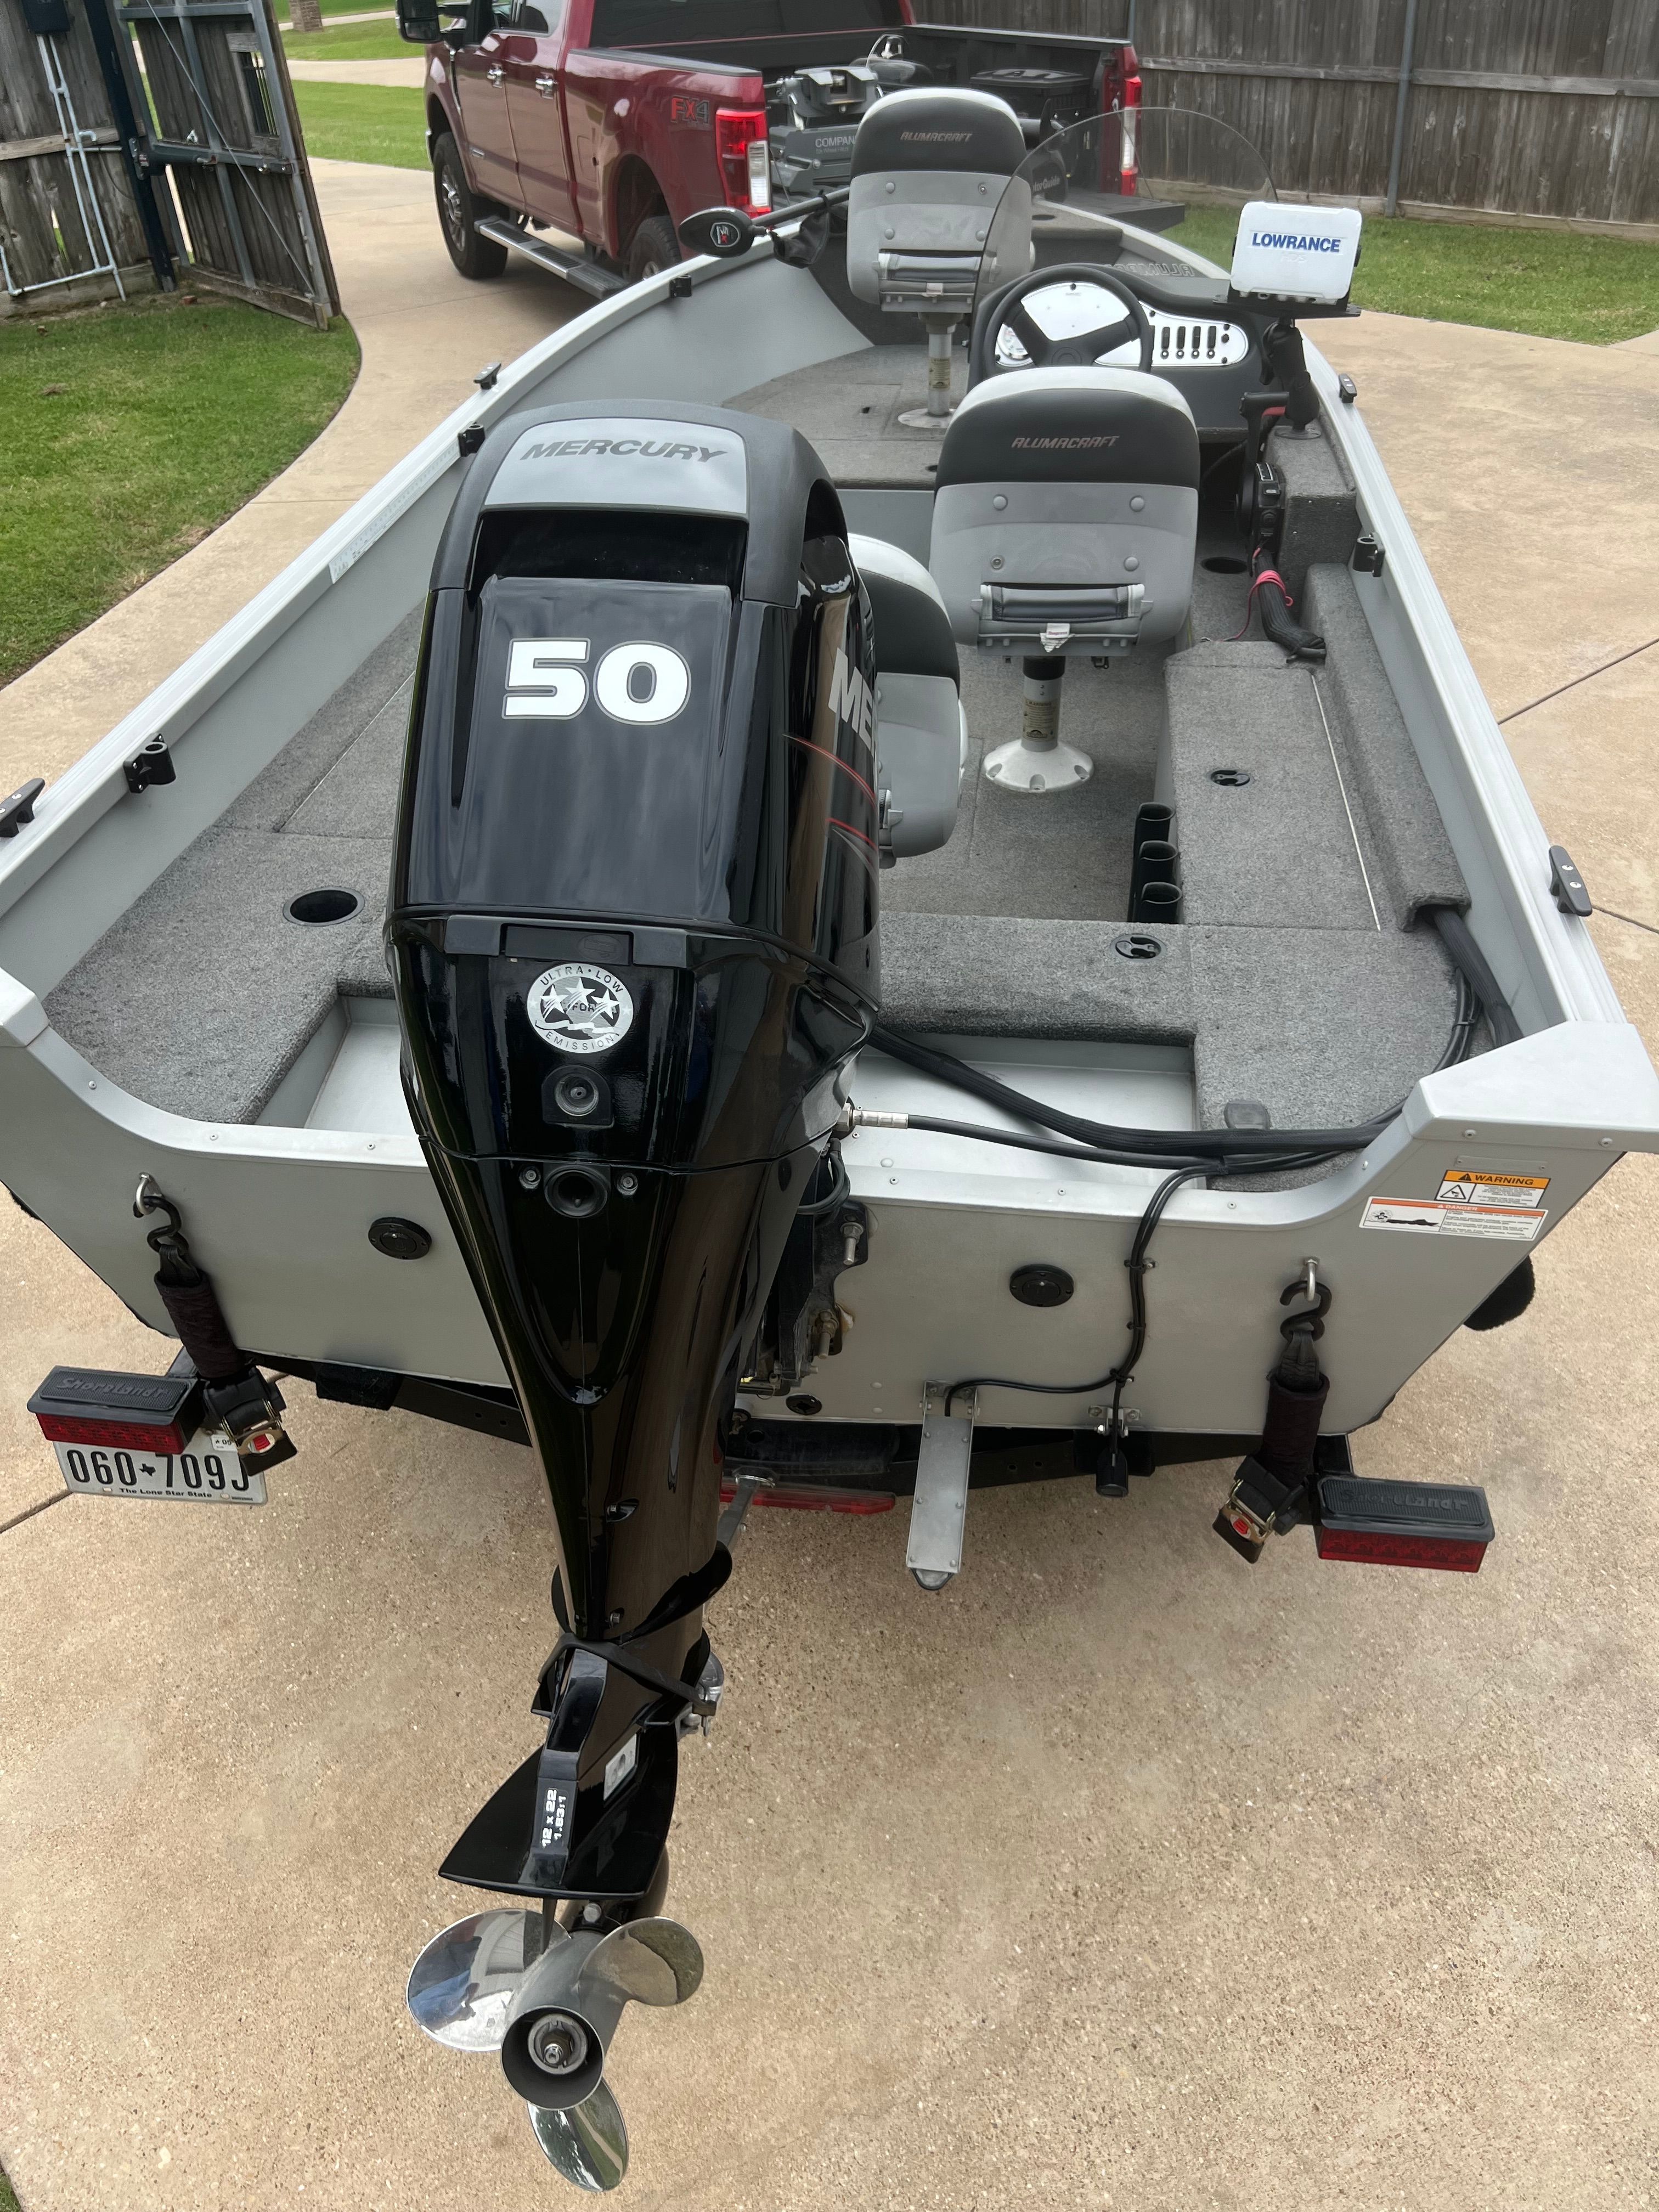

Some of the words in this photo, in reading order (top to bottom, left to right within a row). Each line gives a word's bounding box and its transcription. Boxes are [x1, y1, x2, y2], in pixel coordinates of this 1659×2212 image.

[671, 95, 709, 125] FX4
[900, 131, 972, 142] ALUMACRAFT
[1252, 233, 1341, 252] LOWRANCE
[519, 439, 729, 462] MERCURY
[1011, 436, 1120, 448] ALUMACRAFT
[502, 637, 691, 726] 50
[828, 647, 875, 759] ME
[540, 966, 584, 986] ULTRA
[596, 970, 623, 993] LOW
[546, 1031, 614, 1051] EMISSION
[1475, 1175, 1534, 1186] WARNING
[67, 1449, 137, 1486] 060
[155, 1453, 249, 1492] 709J
[545, 1789, 557, 1812] 22
[554, 1796, 566, 1840] 1.83:1
[542, 1827, 552, 1847] 12
